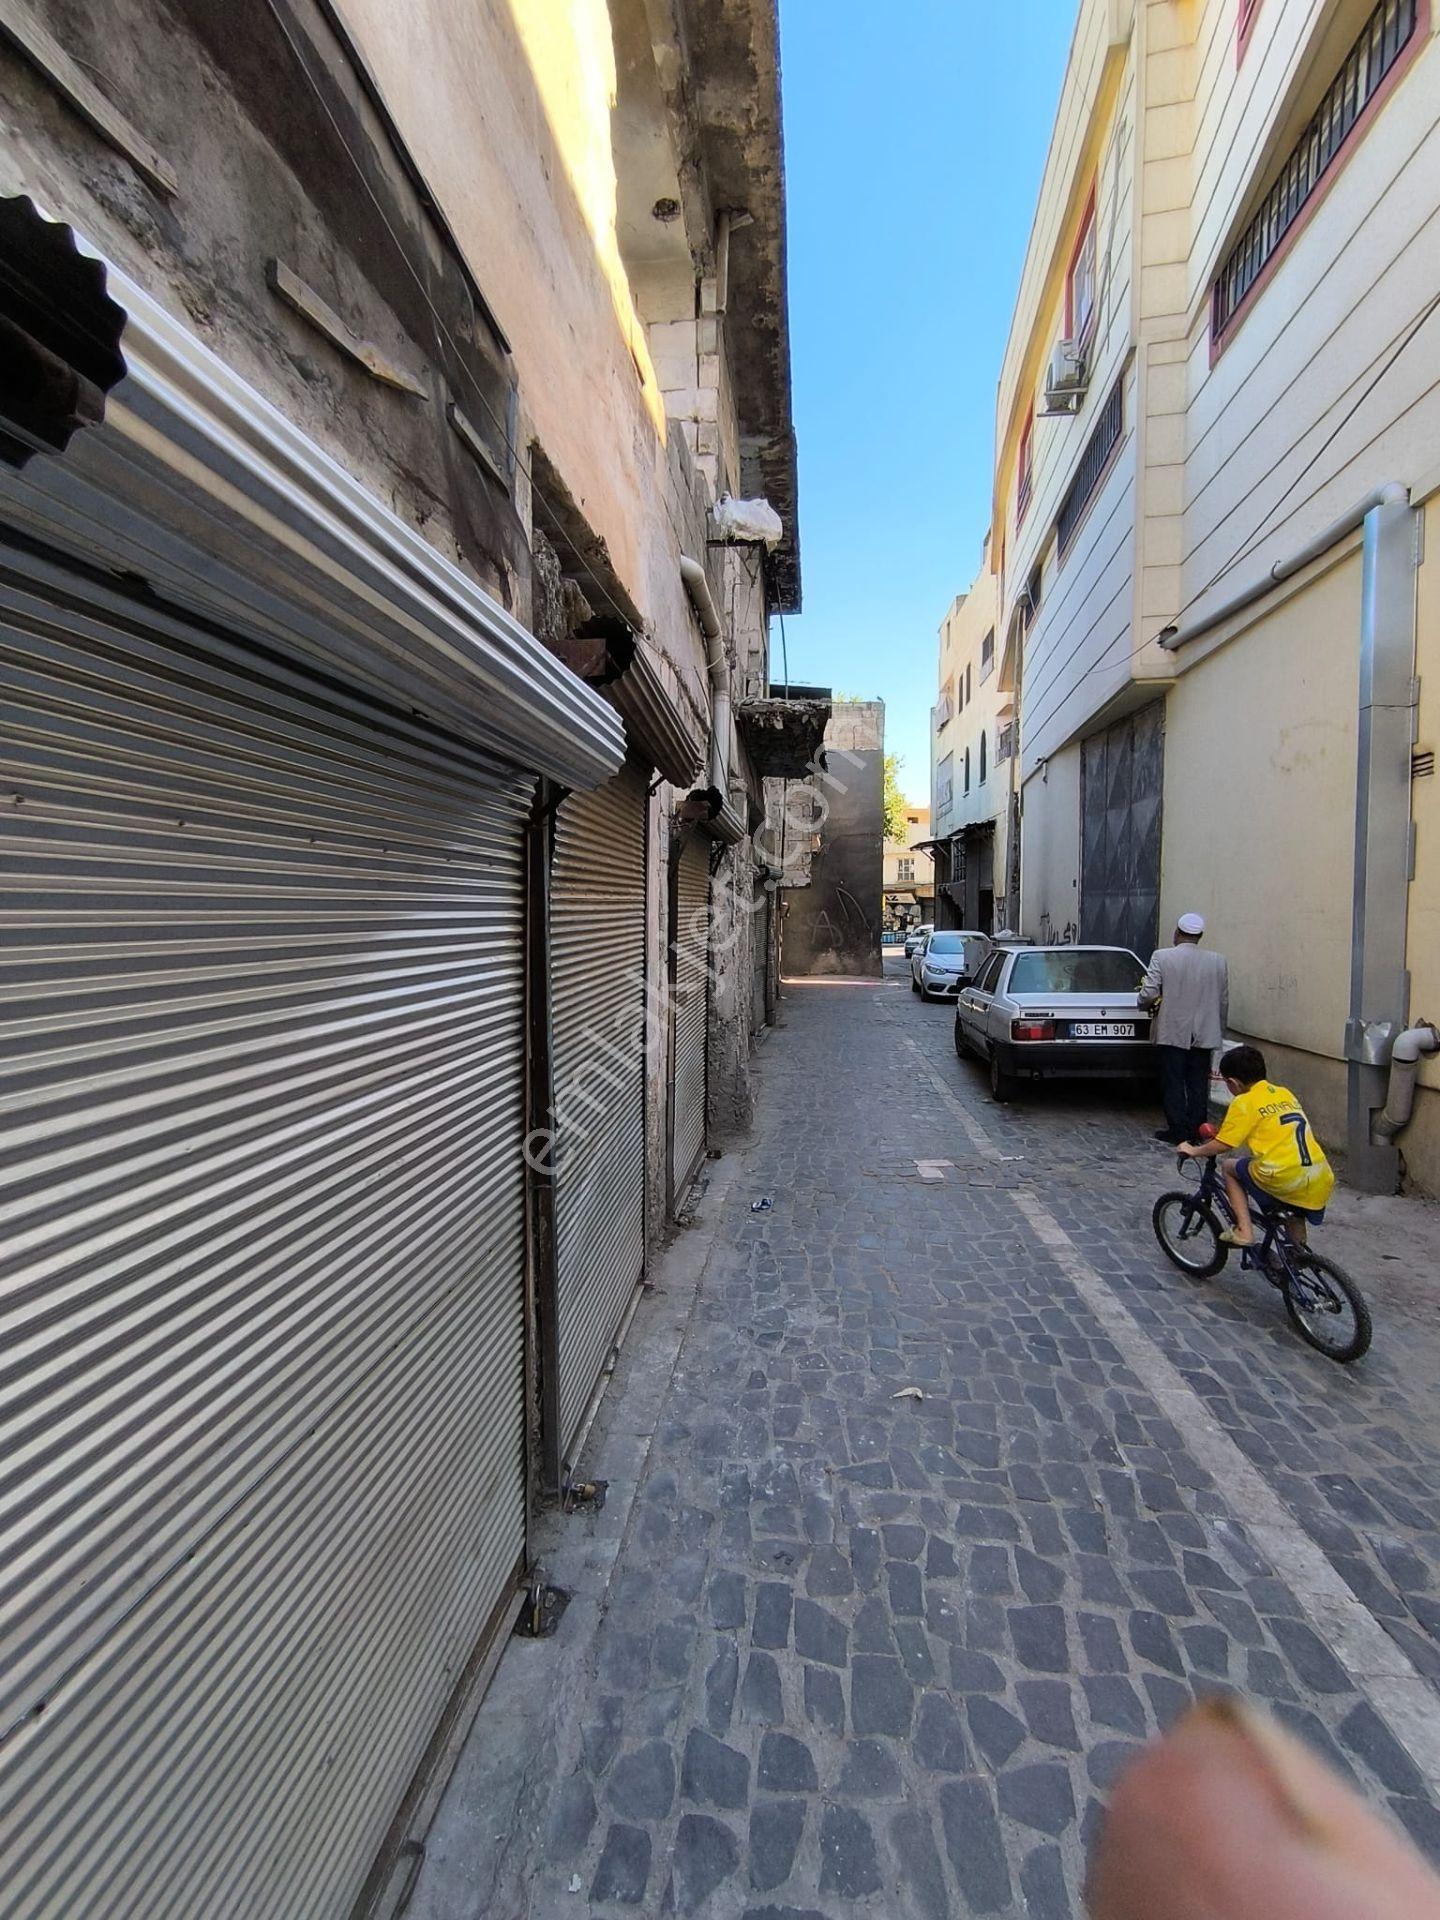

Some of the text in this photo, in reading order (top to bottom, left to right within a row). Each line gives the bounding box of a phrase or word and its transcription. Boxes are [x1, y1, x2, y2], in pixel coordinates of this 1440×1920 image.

[1076, 1024, 1133, 1035] 63 EM 907
[1279, 1112, 1312, 1167] 7
